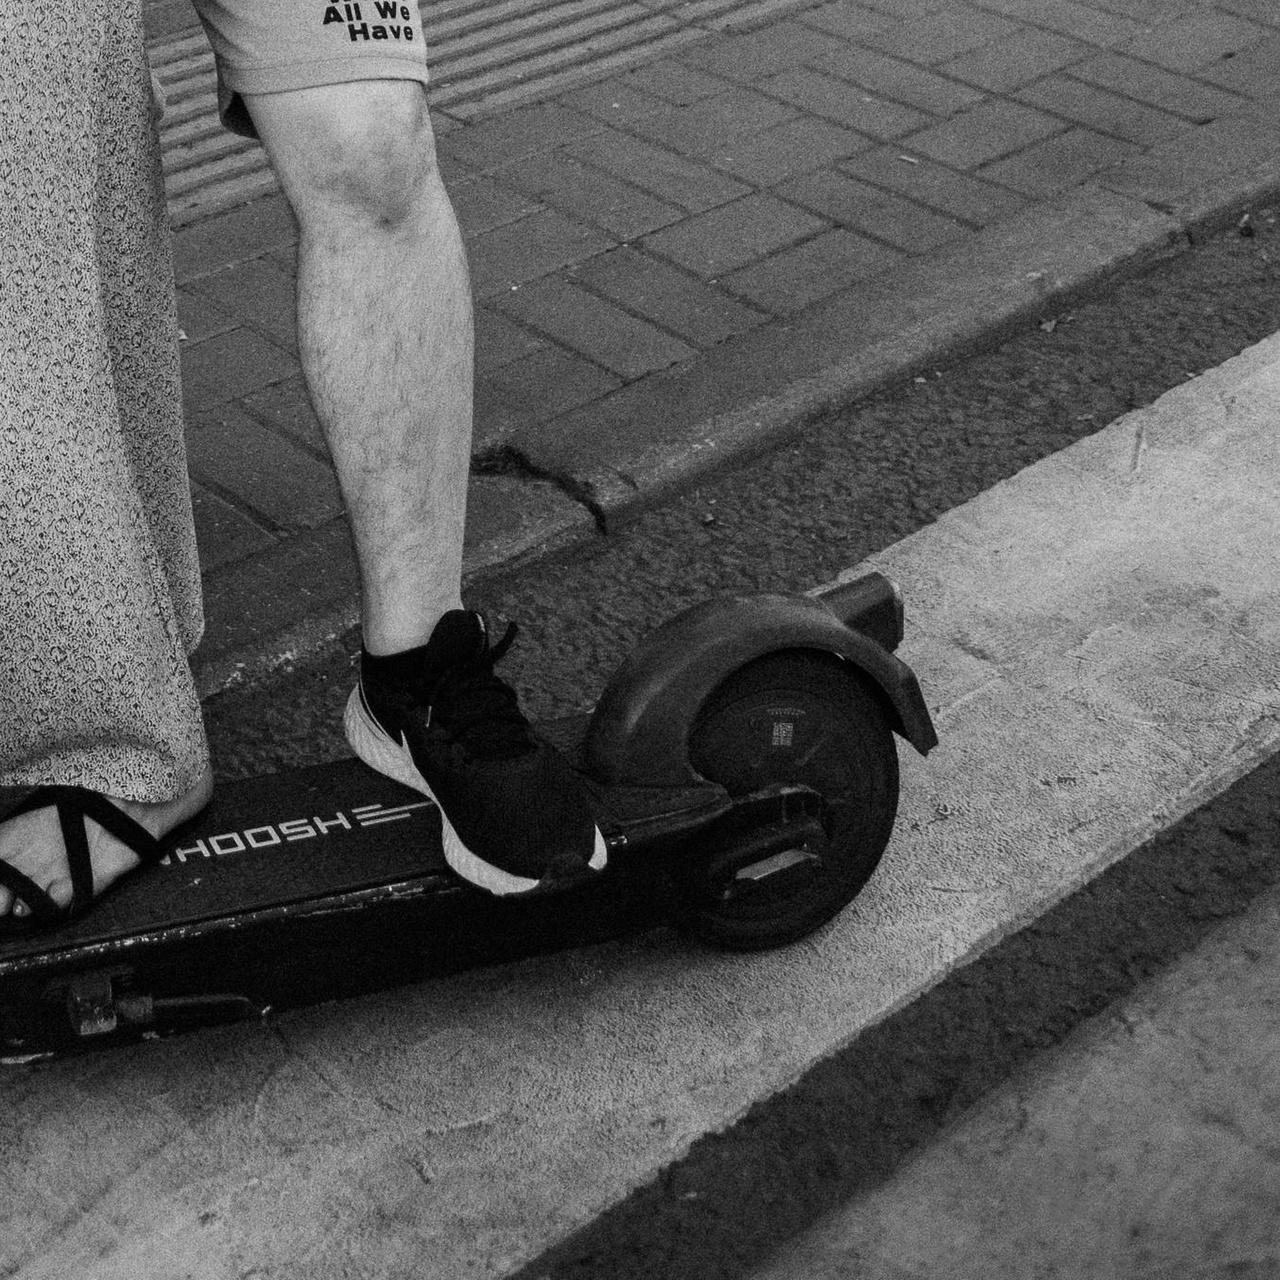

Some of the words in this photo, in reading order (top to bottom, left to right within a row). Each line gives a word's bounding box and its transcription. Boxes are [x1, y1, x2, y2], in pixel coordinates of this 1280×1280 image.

[322, 2, 362, 25] All
[374, 1, 410, 21] We
[348, 22, 414, 42] Have
[160, 811, 352, 866] HOOSH
